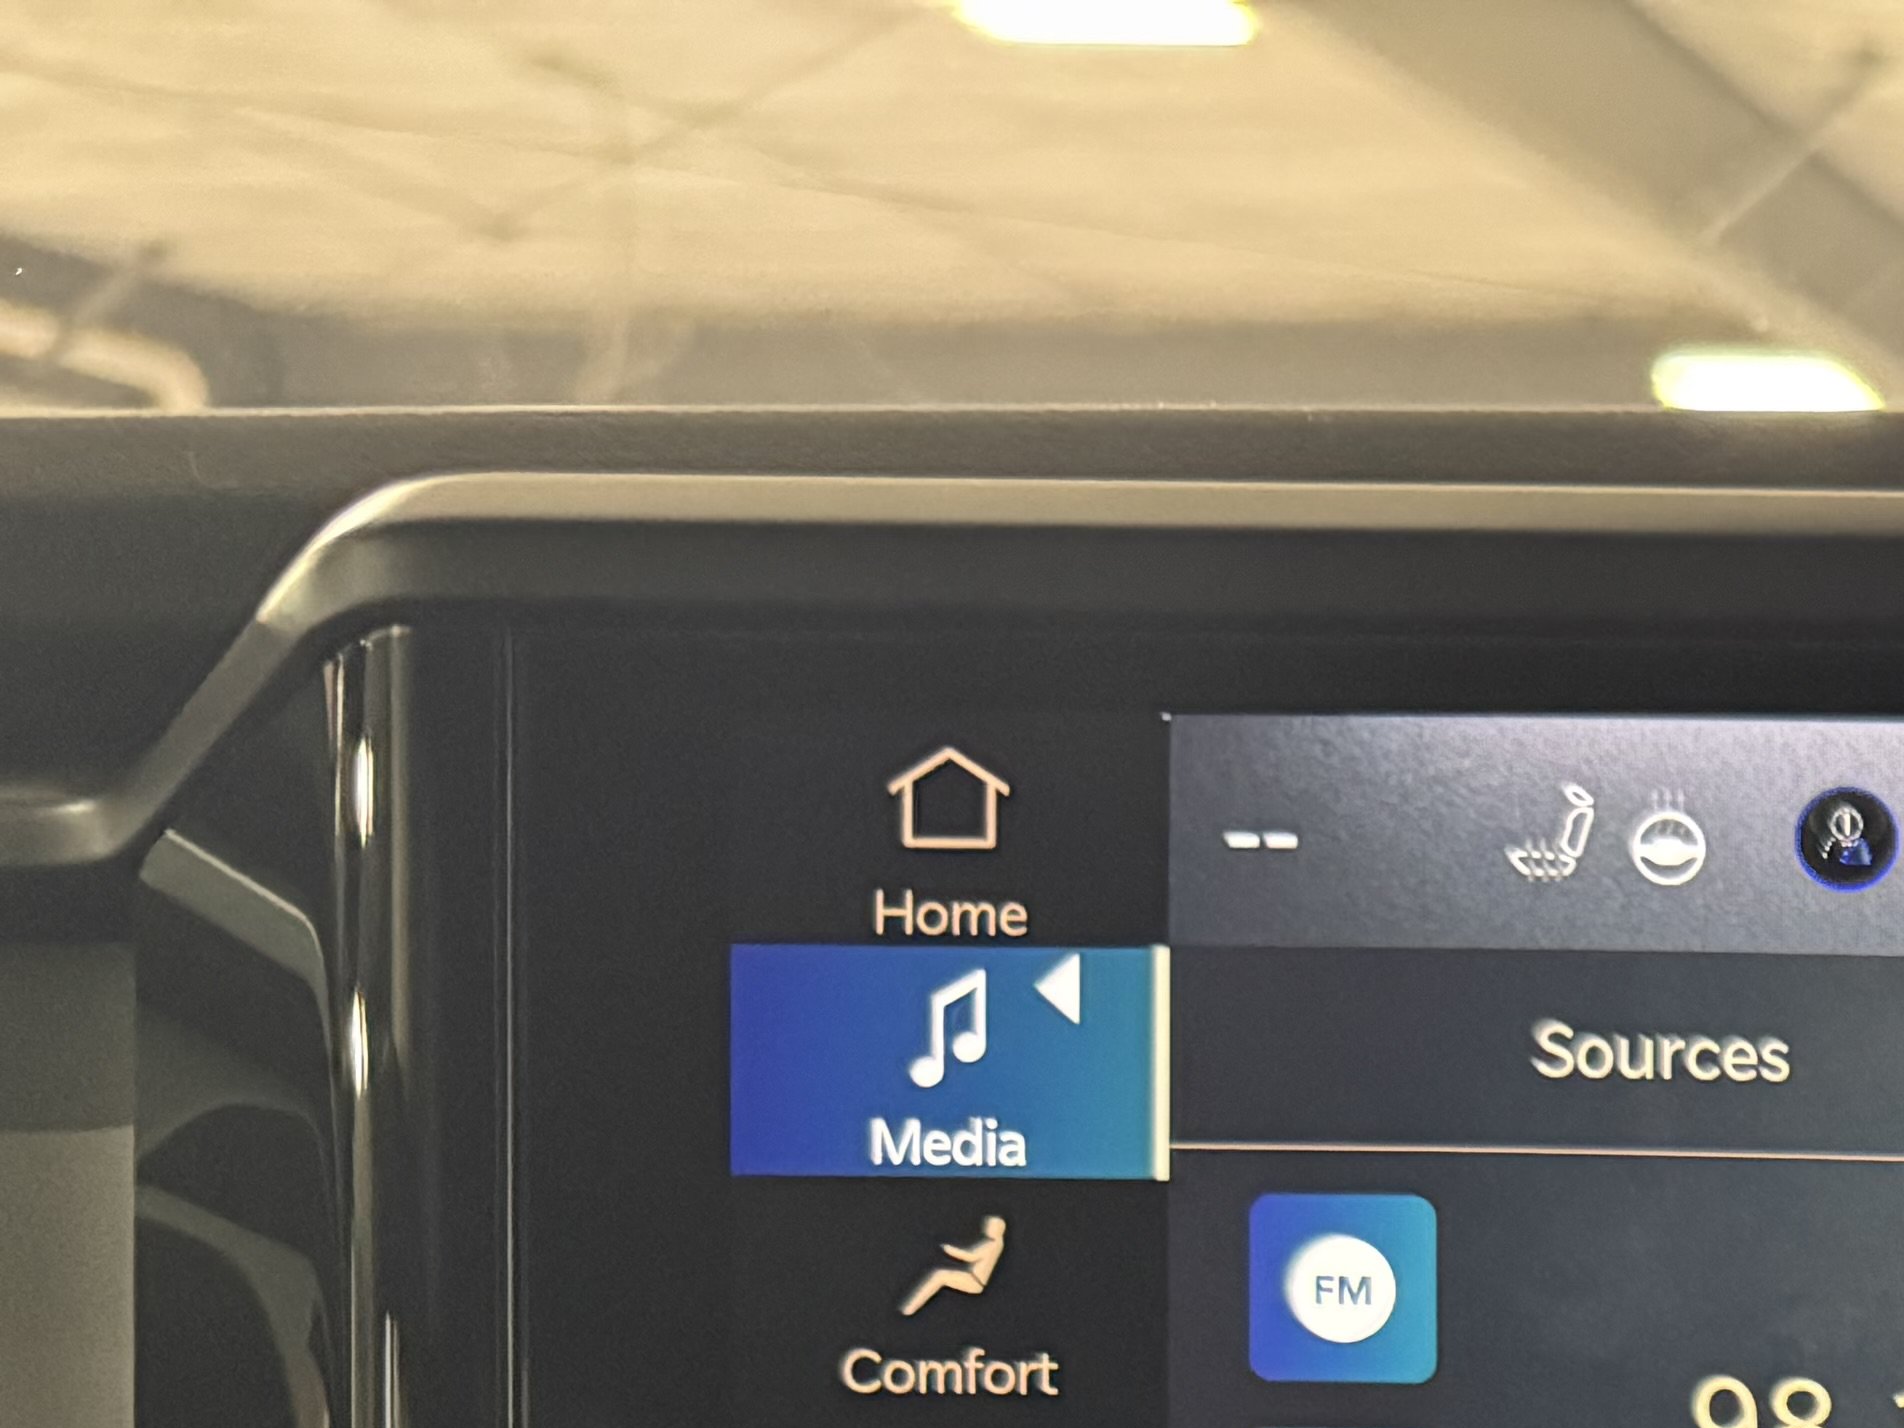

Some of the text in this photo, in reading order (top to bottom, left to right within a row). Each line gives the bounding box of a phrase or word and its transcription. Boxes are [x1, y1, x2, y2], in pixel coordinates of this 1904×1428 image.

[873, 887, 1029, 937] Home
[1529, 1018, 1792, 1083] Sources
[868, 1117, 1027, 1168] Media
[1314, 1274, 1372, 1307] FM
[838, 1347, 1060, 1398] Comfort
